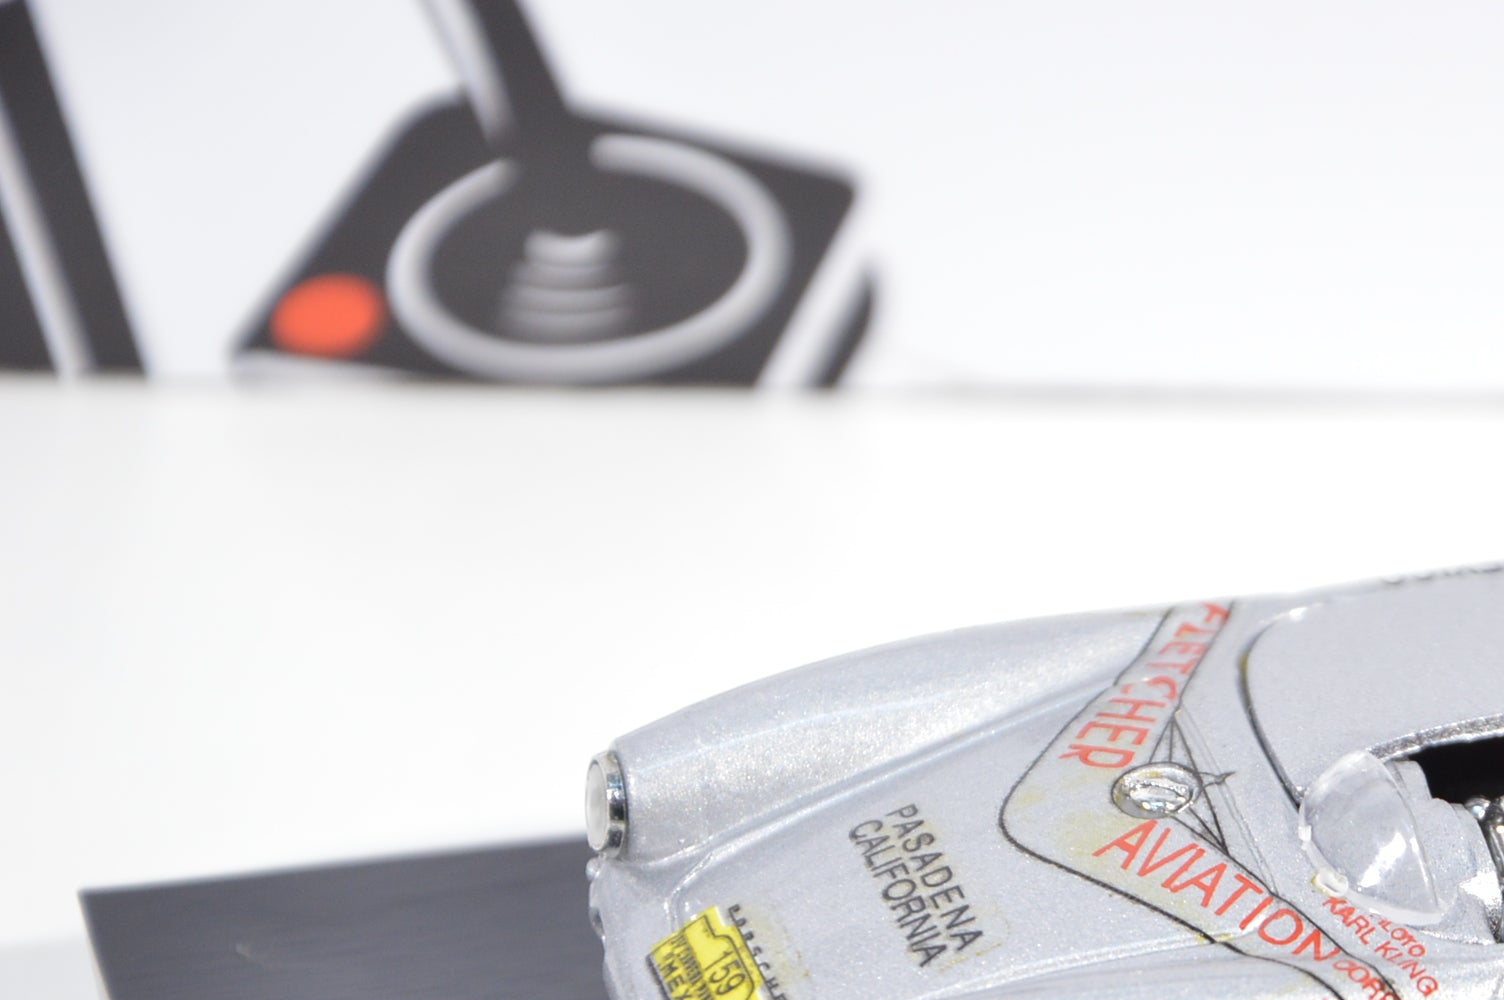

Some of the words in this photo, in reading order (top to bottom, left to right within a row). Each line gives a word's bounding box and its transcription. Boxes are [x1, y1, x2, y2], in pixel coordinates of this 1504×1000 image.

[1059, 601, 1228, 770] FLETCHER
[848, 819, 949, 968] CALIFORNIA
[884, 804, 983, 954] PASADENA
[1093, 820, 1341, 963] AVIATION
[1322, 896, 1376, 945] KARL
[702, 949, 747, 996] 159
